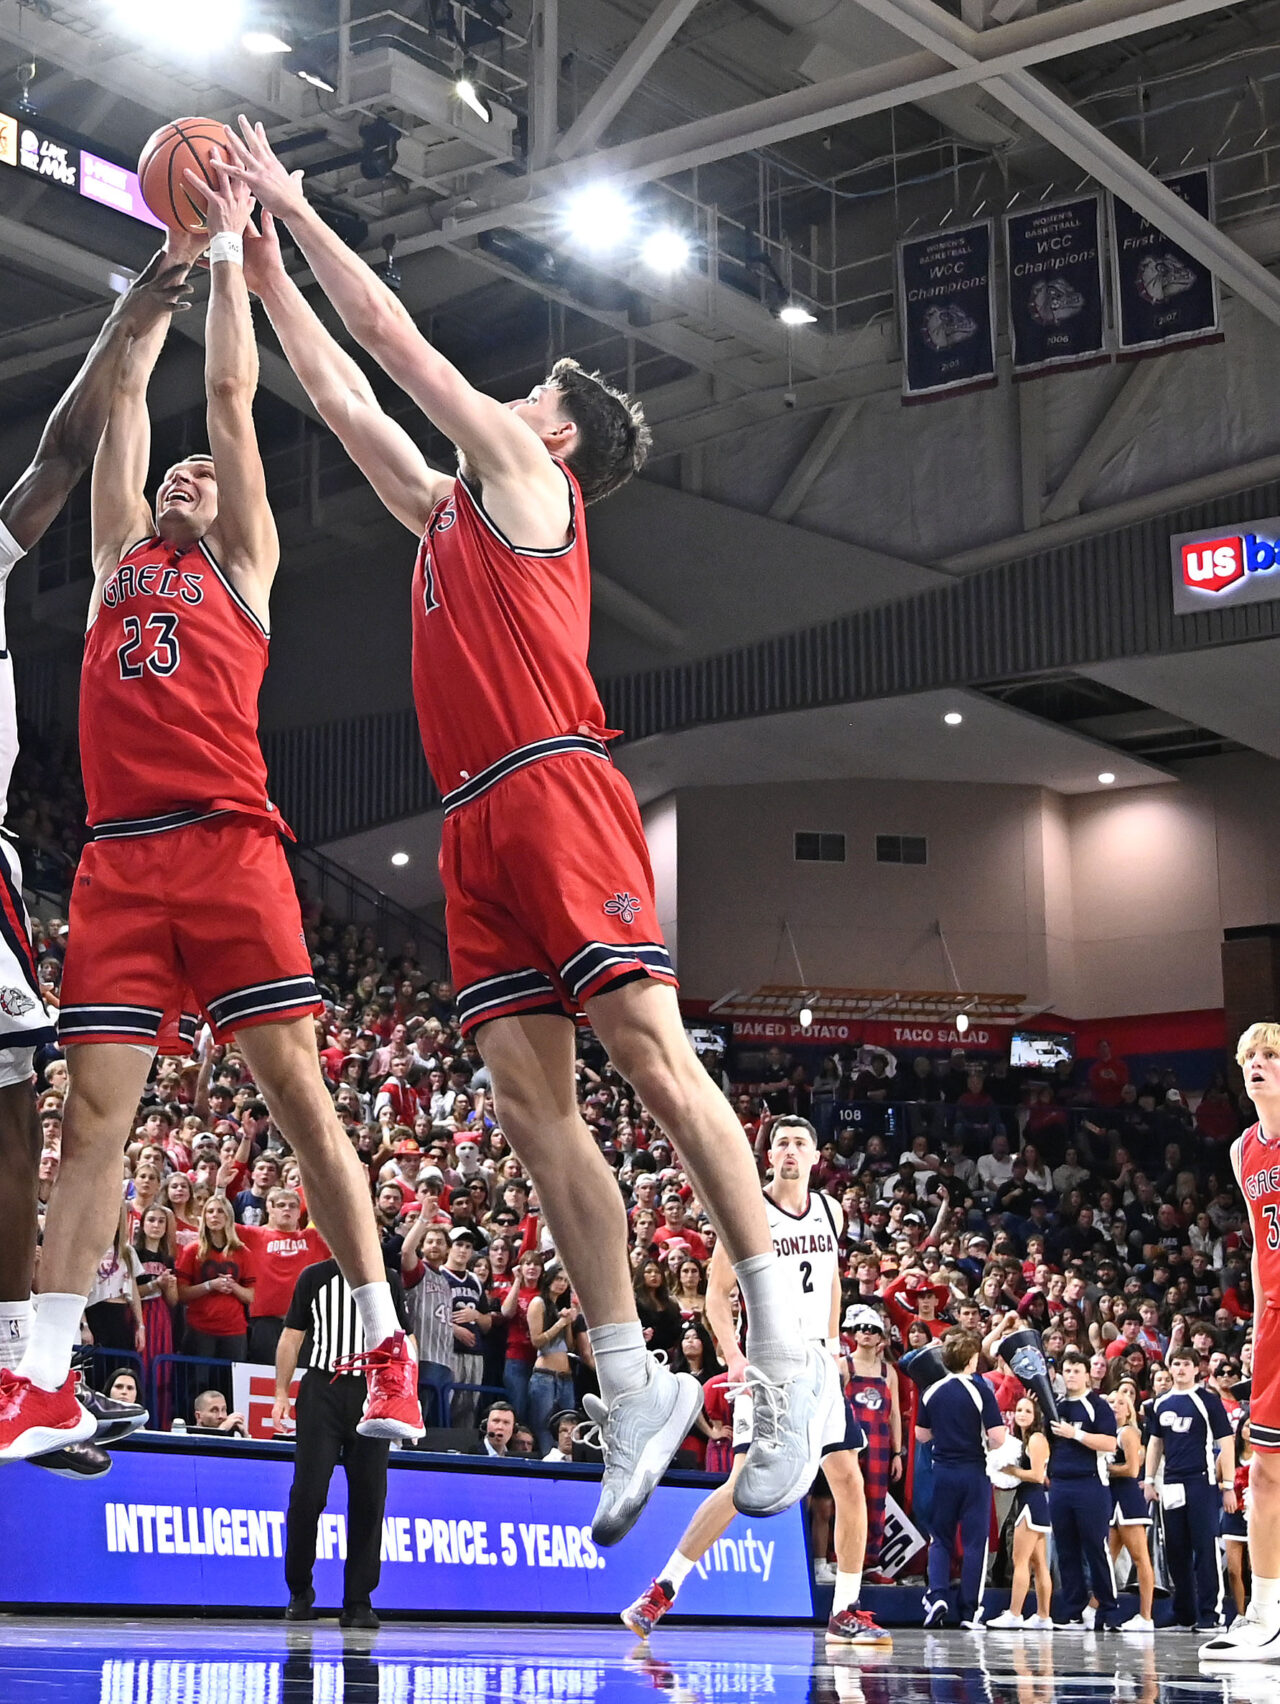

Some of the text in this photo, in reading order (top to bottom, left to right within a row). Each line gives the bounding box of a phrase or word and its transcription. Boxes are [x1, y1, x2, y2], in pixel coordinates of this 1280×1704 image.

[1035, 234, 1073, 254] WCC
[1123, 233, 1155, 250] First
[928, 260, 966, 280] WCC
[1013, 249, 1096, 277] Champions
[907, 275, 987, 303] Champions
[102, 563, 204, 608] GAELS
[117, 612, 181, 680] 23
[732, 1021, 849, 1040] BAKED POTATO
[894, 1027, 990, 1045] TACO SALAD
[839, 1108, 862, 1122] 108
[1245, 1165, 1280, 1200] GAE
[1261, 1204, 1280, 1251] 3
[772, 1234, 834, 1258] GONZAGA
[799, 1260, 814, 1294] 2
[1159, 1410, 1193, 1433] GU
[105, 1502, 285, 1558] INTELLIGENT
[380, 1516, 413, 1562] NE
[414, 1517, 498, 1566] PRICE.
[500, 1522, 518, 1567] 5
[518, 1522, 607, 1569] YEARS.
